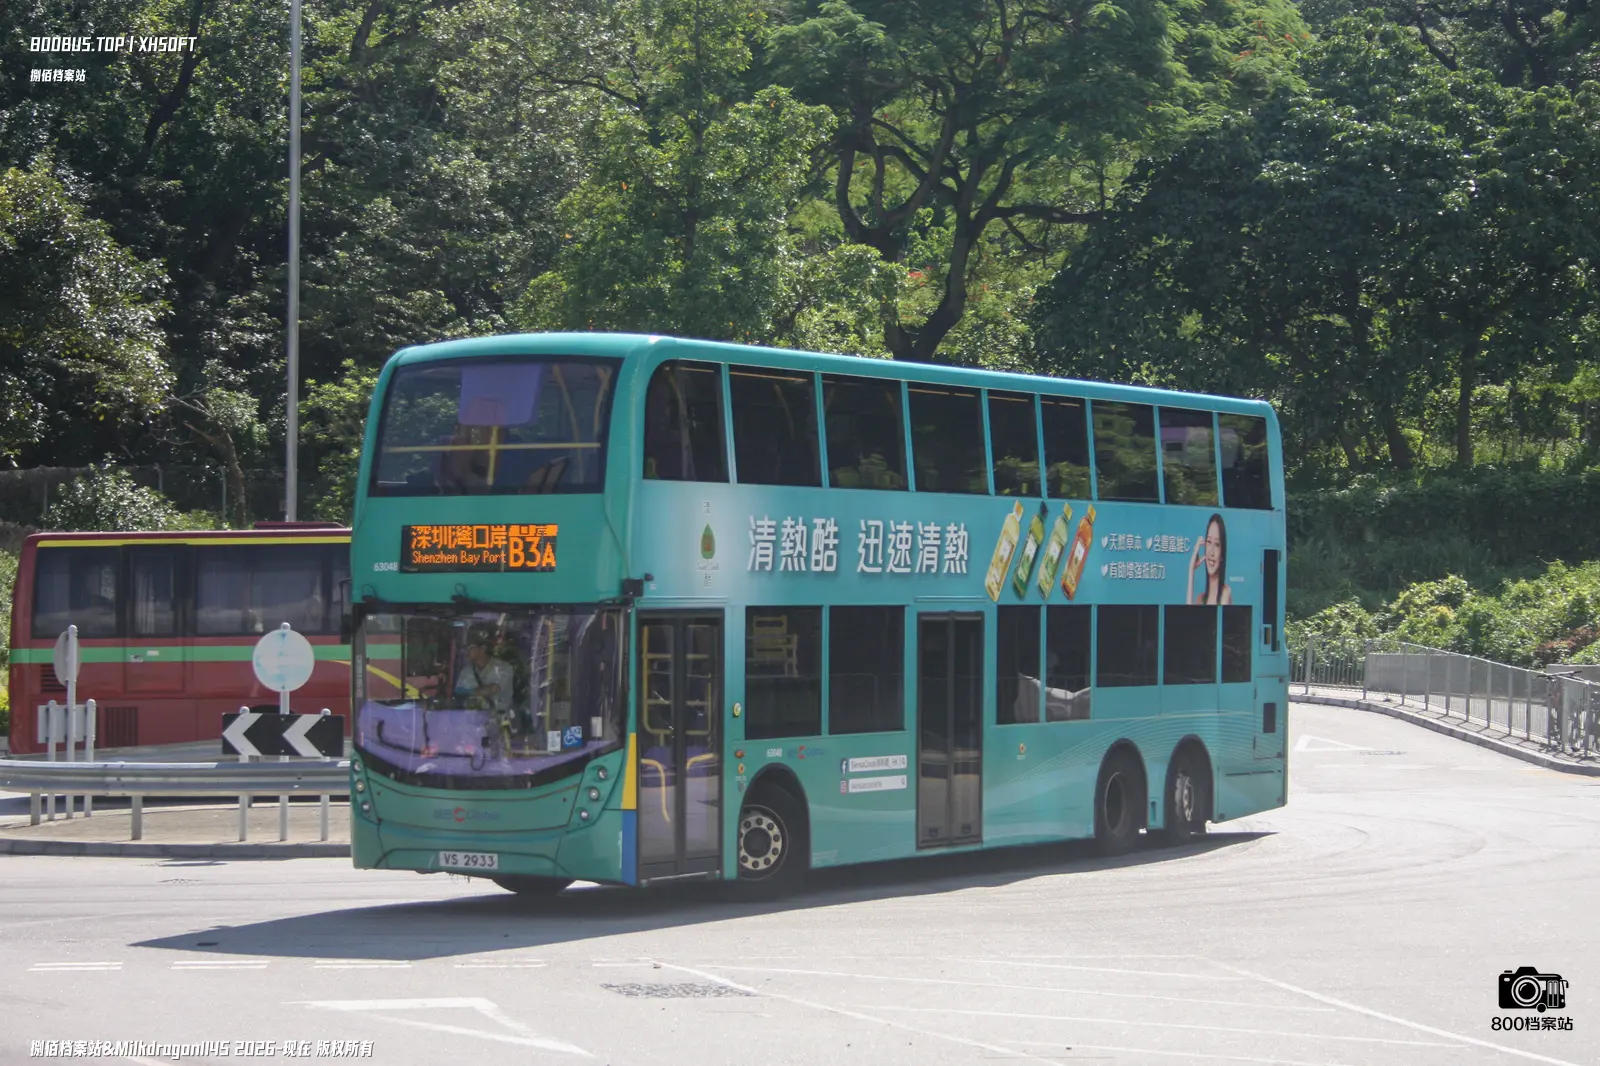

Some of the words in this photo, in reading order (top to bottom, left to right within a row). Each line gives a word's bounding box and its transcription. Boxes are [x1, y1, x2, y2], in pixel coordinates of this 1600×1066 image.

[411, 525, 507, 549] 深圳灣口岸
[747, 515, 839, 572] 清熱酷
[857, 519, 968, 574] 迅速清熱
[1109, 533, 1142, 551] 天然草本
[412, 550, 458, 564] Shenzhen
[460, 550, 480, 566] Bay
[483, 551, 506, 564] Port
[509, 536, 556, 567] B3A
[374, 562, 398, 572] 63048
[444, 853, 459, 866] VS
[463, 854, 495, 868] 2933
